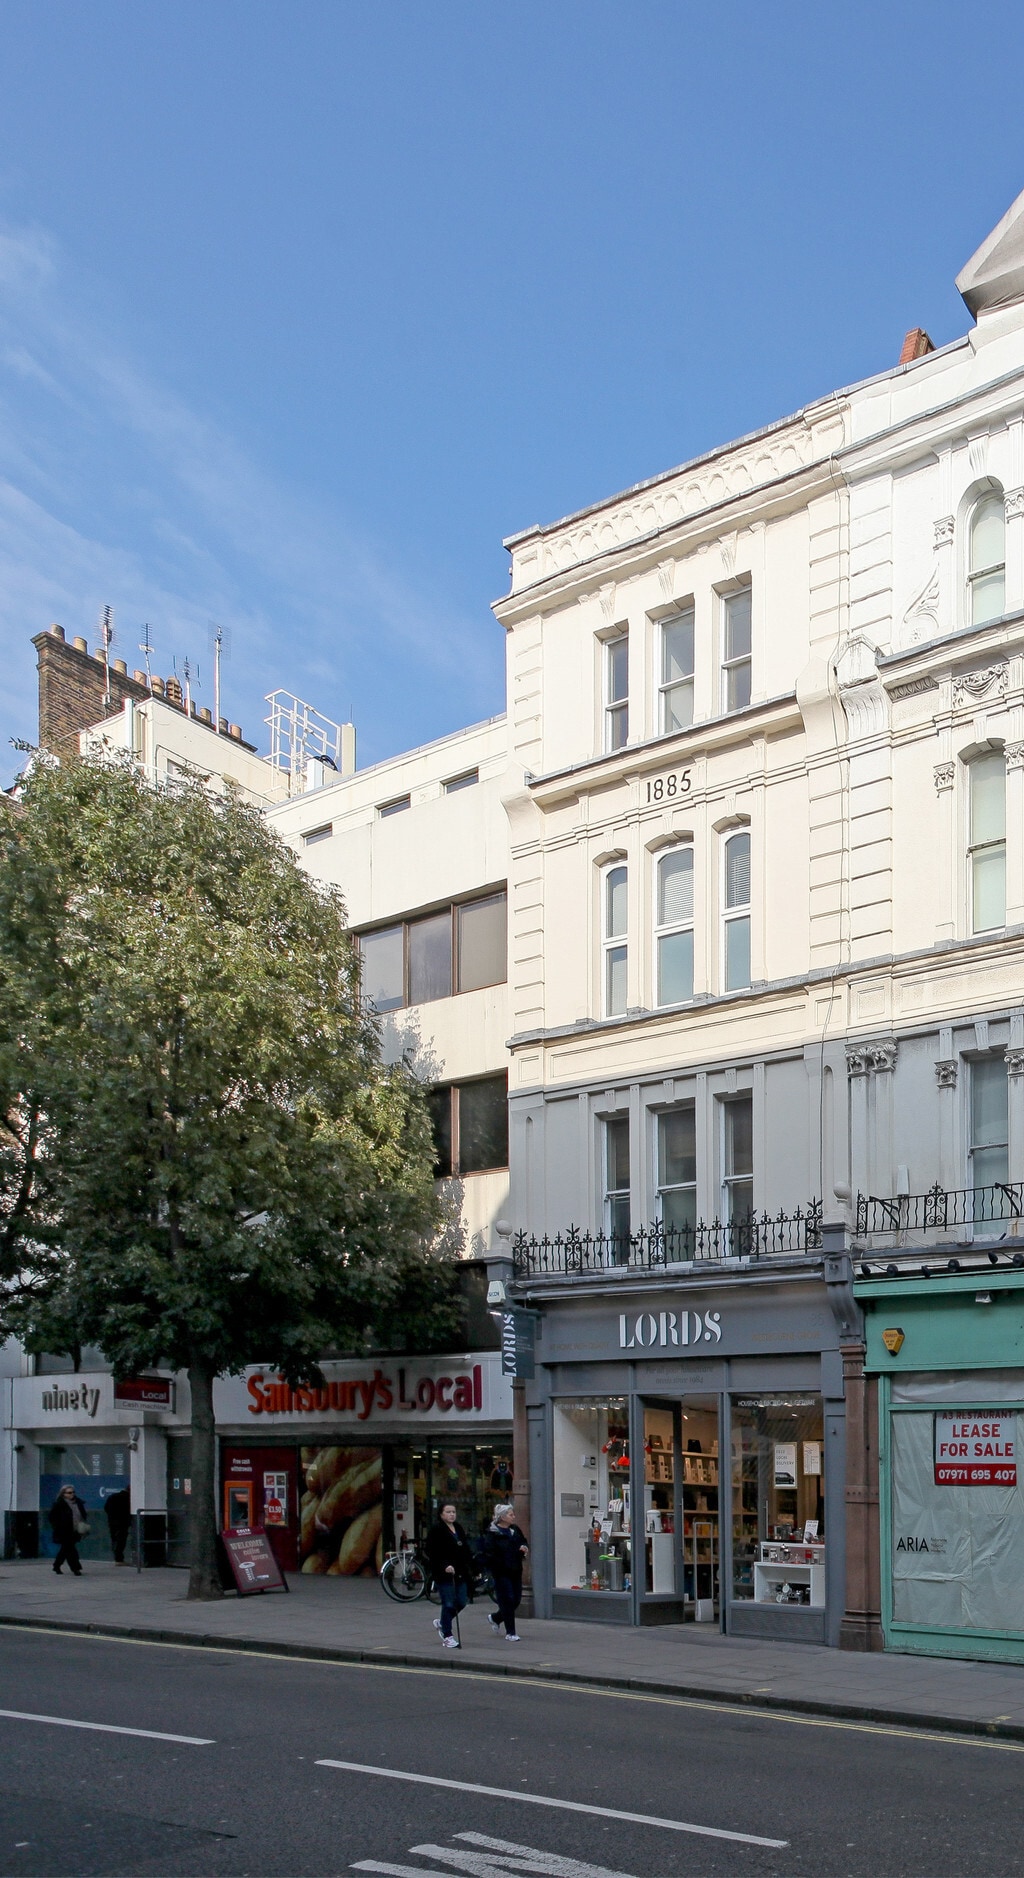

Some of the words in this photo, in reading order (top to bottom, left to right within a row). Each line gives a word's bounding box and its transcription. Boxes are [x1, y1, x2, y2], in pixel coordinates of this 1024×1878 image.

[647, 769, 691, 803] 1885
[619, 1309, 722, 1348] LORDS
[503, 1313, 517, 1378] LORDS
[398, 1364, 482, 1410] Local
[42, 1382, 100, 1418] ninety
[141, 1390, 167, 1400] Local
[140, 1402, 167, 1410] machine
[942, 1411, 954, 1420] A3
[956, 1410, 1013, 1419] RESTAURANT
[952, 1424, 1001, 1438] LEASE
[940, 1442, 969, 1457] FOR
[974, 1442, 1014, 1457] SALE
[938, 1469, 968, 1480] 07971
[970, 1470, 991, 1480] 695
[994, 1470, 1016, 1480] 407
[268, 1505, 282, 1513] £1.50
[230, 1539, 264, 1550] WELCOME
[896, 1536, 930, 1552] ARIA
